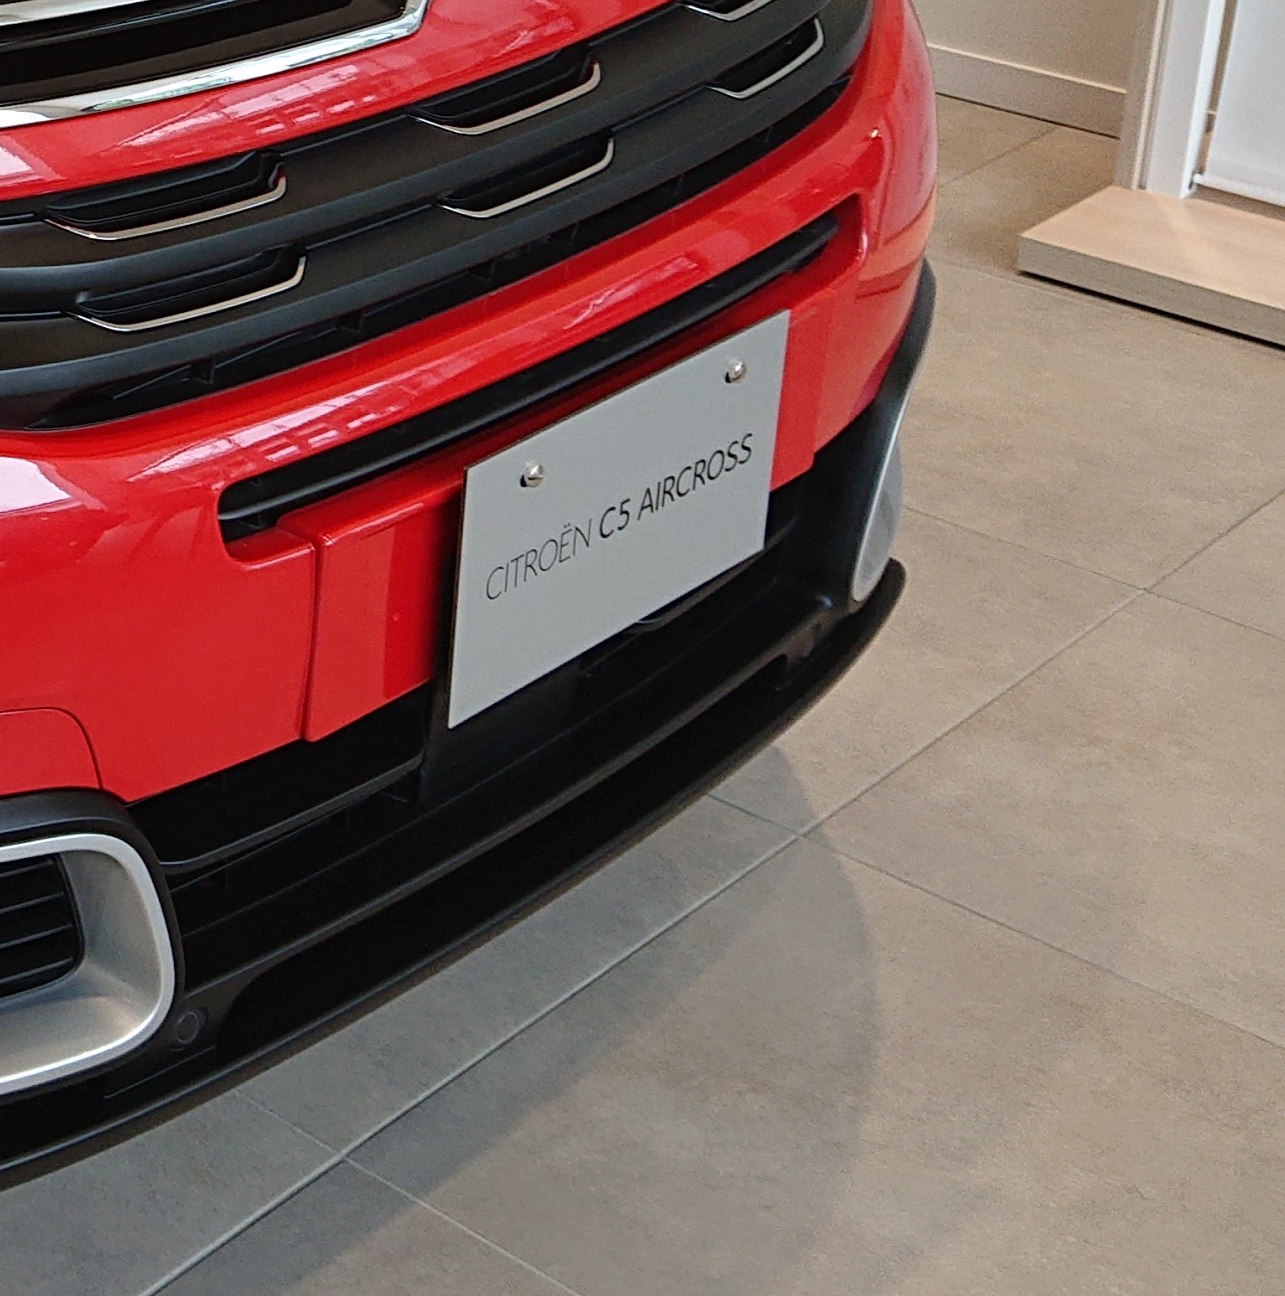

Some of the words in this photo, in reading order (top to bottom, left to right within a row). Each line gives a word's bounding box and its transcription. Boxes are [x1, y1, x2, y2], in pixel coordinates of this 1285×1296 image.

[485, 518, 592, 600] CITROËN
[599, 498, 631, 540] C5
[637, 432, 754, 522] AIRCROSS
